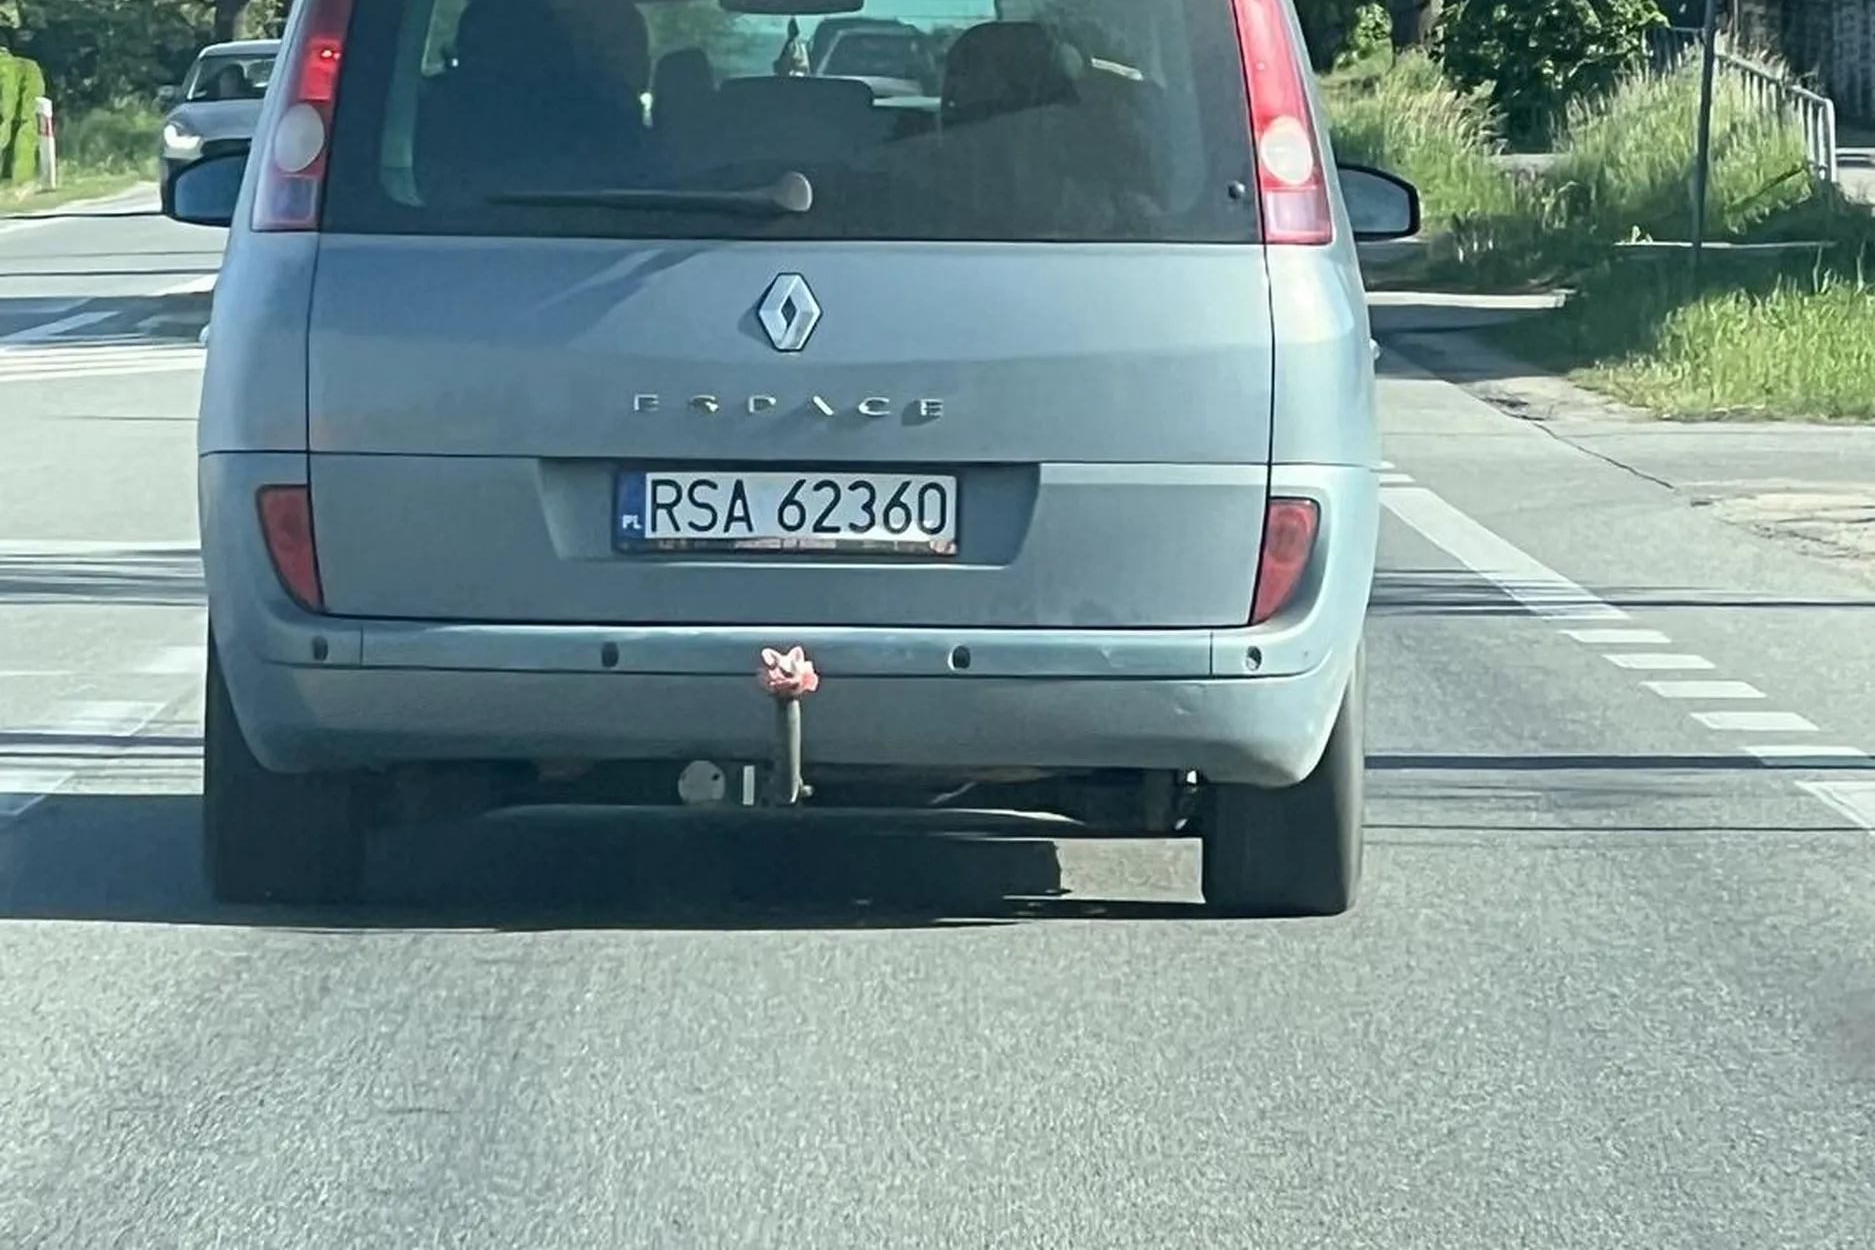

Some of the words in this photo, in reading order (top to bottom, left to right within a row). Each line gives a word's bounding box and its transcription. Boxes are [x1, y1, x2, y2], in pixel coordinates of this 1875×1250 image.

[633, 394, 945, 416] ESPACE
[650, 478, 754, 534] RSA
[776, 478, 948, 535] 62360
[622, 514, 642, 529] PL
